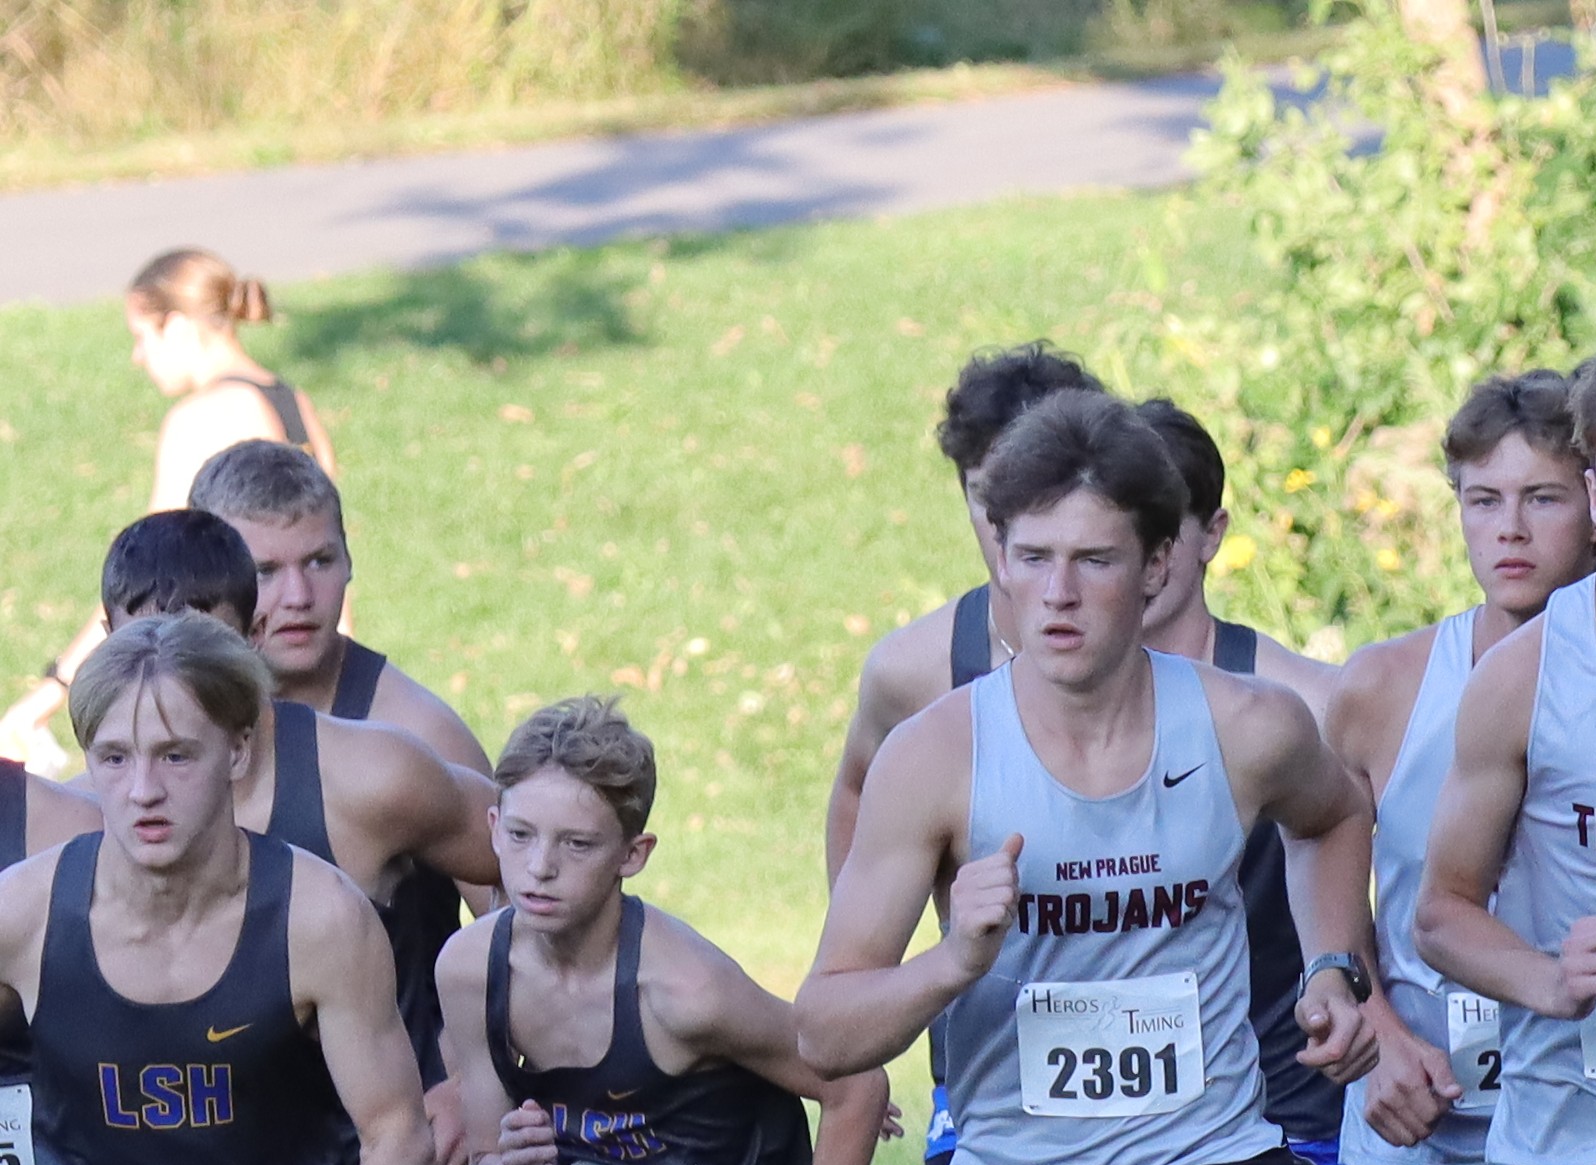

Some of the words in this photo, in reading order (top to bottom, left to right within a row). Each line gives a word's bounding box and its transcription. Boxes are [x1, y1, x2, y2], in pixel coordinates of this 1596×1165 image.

[1056, 860, 1092, 881] NEW
[1096, 854, 1161, 878] PRAGUE
[1018, 879, 1209, 936] TROJANS
[1121, 1009, 1184, 1034] TIMING
[98, 1062, 234, 1130] LSH
[1047, 1042, 1178, 1101] 2391
